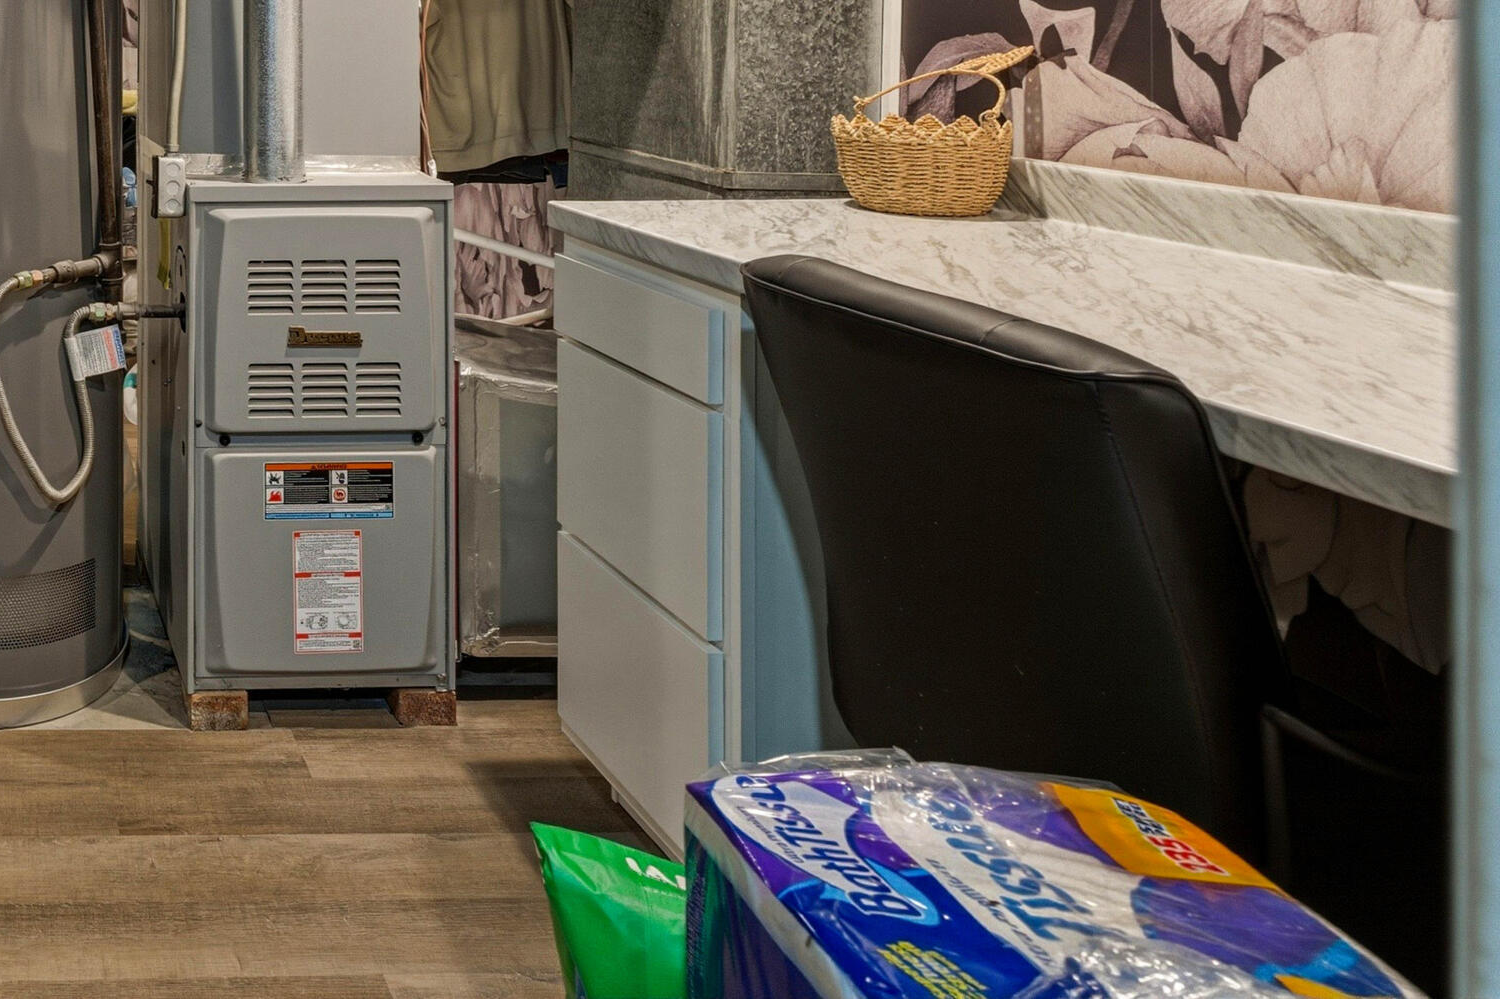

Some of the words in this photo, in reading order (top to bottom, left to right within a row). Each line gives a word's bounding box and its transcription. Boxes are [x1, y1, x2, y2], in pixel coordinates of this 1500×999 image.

[735, 775, 842, 848] Tissue
[802, 846, 924, 918] Bath
[1145, 835, 1231, 876] 235
